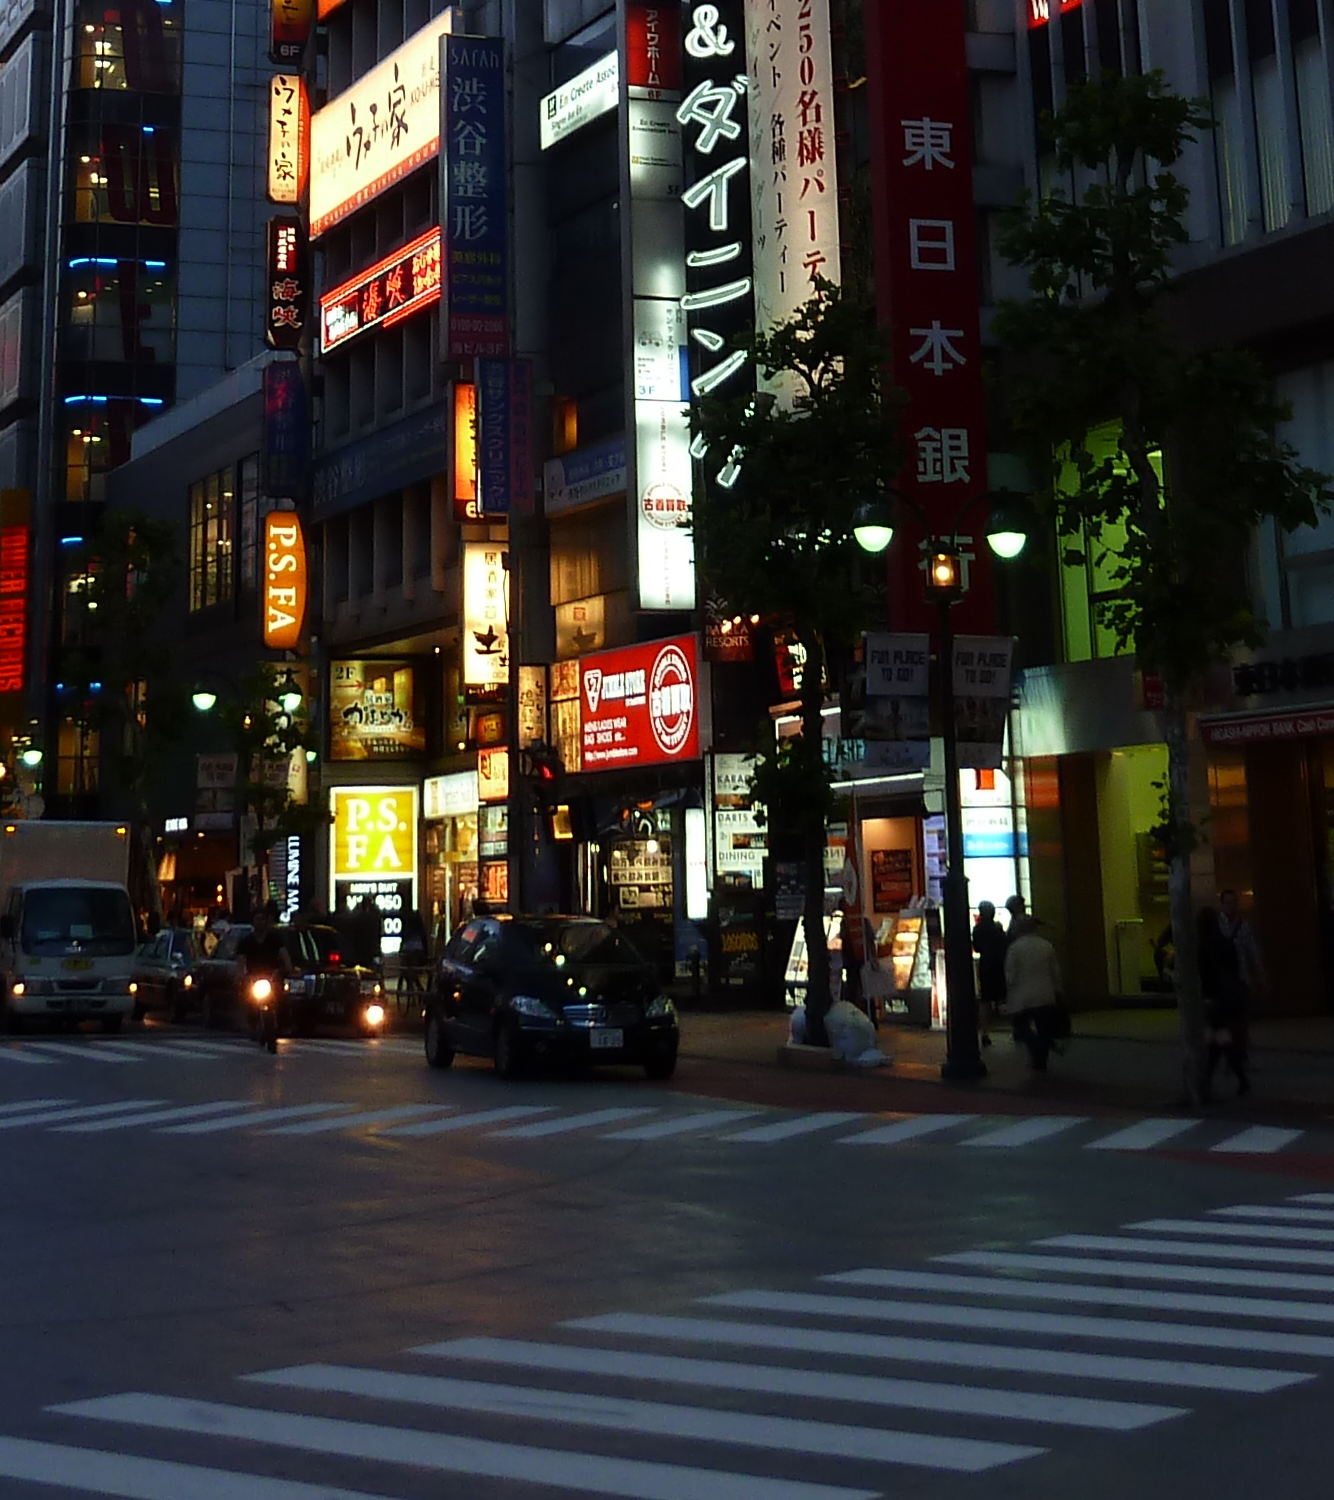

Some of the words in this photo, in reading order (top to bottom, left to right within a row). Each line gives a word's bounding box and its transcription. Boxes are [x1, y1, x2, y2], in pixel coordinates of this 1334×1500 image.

[283, 43, 300, 57] 6F
[645, 8, 662, 86] アイワホーム
[451, 78, 489, 241] 渋谷整形
[272, 278, 302, 329] 海峡
[0, 527, 28, 594] TOWER
[268, 524, 297, 633] P.S.FA
[705, 636, 750, 649] RESORTS
[893, 650, 926, 664] PLACE
[335, 665, 355, 680] 2F
[345, 797, 407, 833] P.S.
[717, 813, 749, 823] DARTS
[718, 850, 756, 861] DINING
